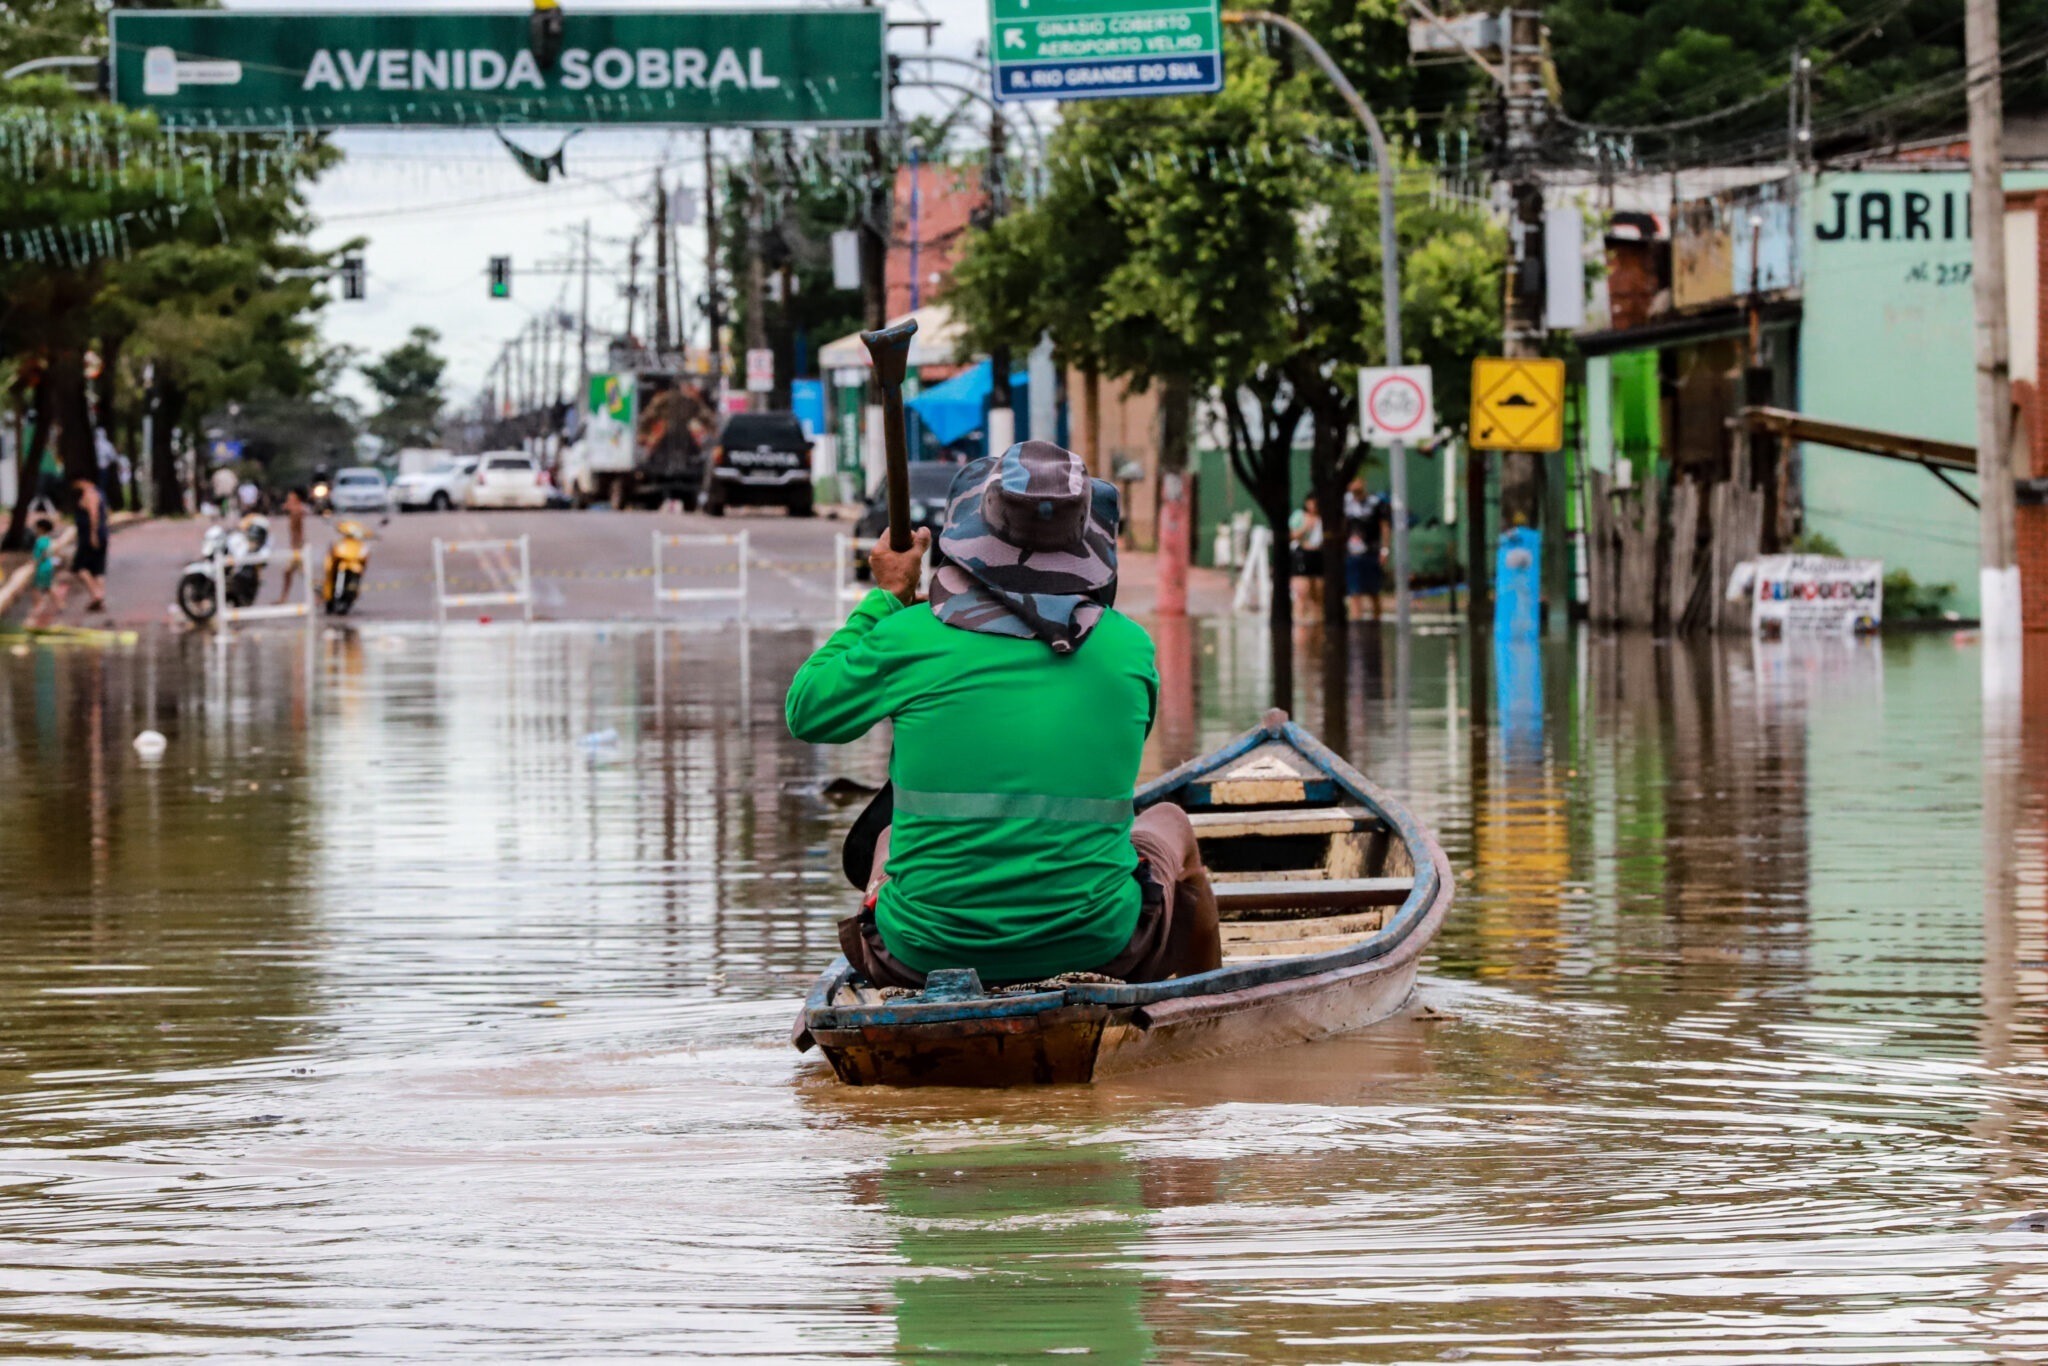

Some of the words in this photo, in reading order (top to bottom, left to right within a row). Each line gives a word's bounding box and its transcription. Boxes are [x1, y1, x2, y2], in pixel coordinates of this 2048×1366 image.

[1109, 14, 1191, 33] COBERTO
[1038, 37, 1142, 56] AEROPORTO
[1145, 34, 1203, 51] VELHO
[302, 49, 546, 91] AVENIDA
[560, 47, 780, 90] SOBRAL
[1031, 69, 1064, 87] RIO
[1065, 66, 1137, 86] GRANDE
[1139, 64, 1166, 82] DO
[1168, 62, 1203, 80] SUL
[729, 451, 799, 467] TOYOTA
